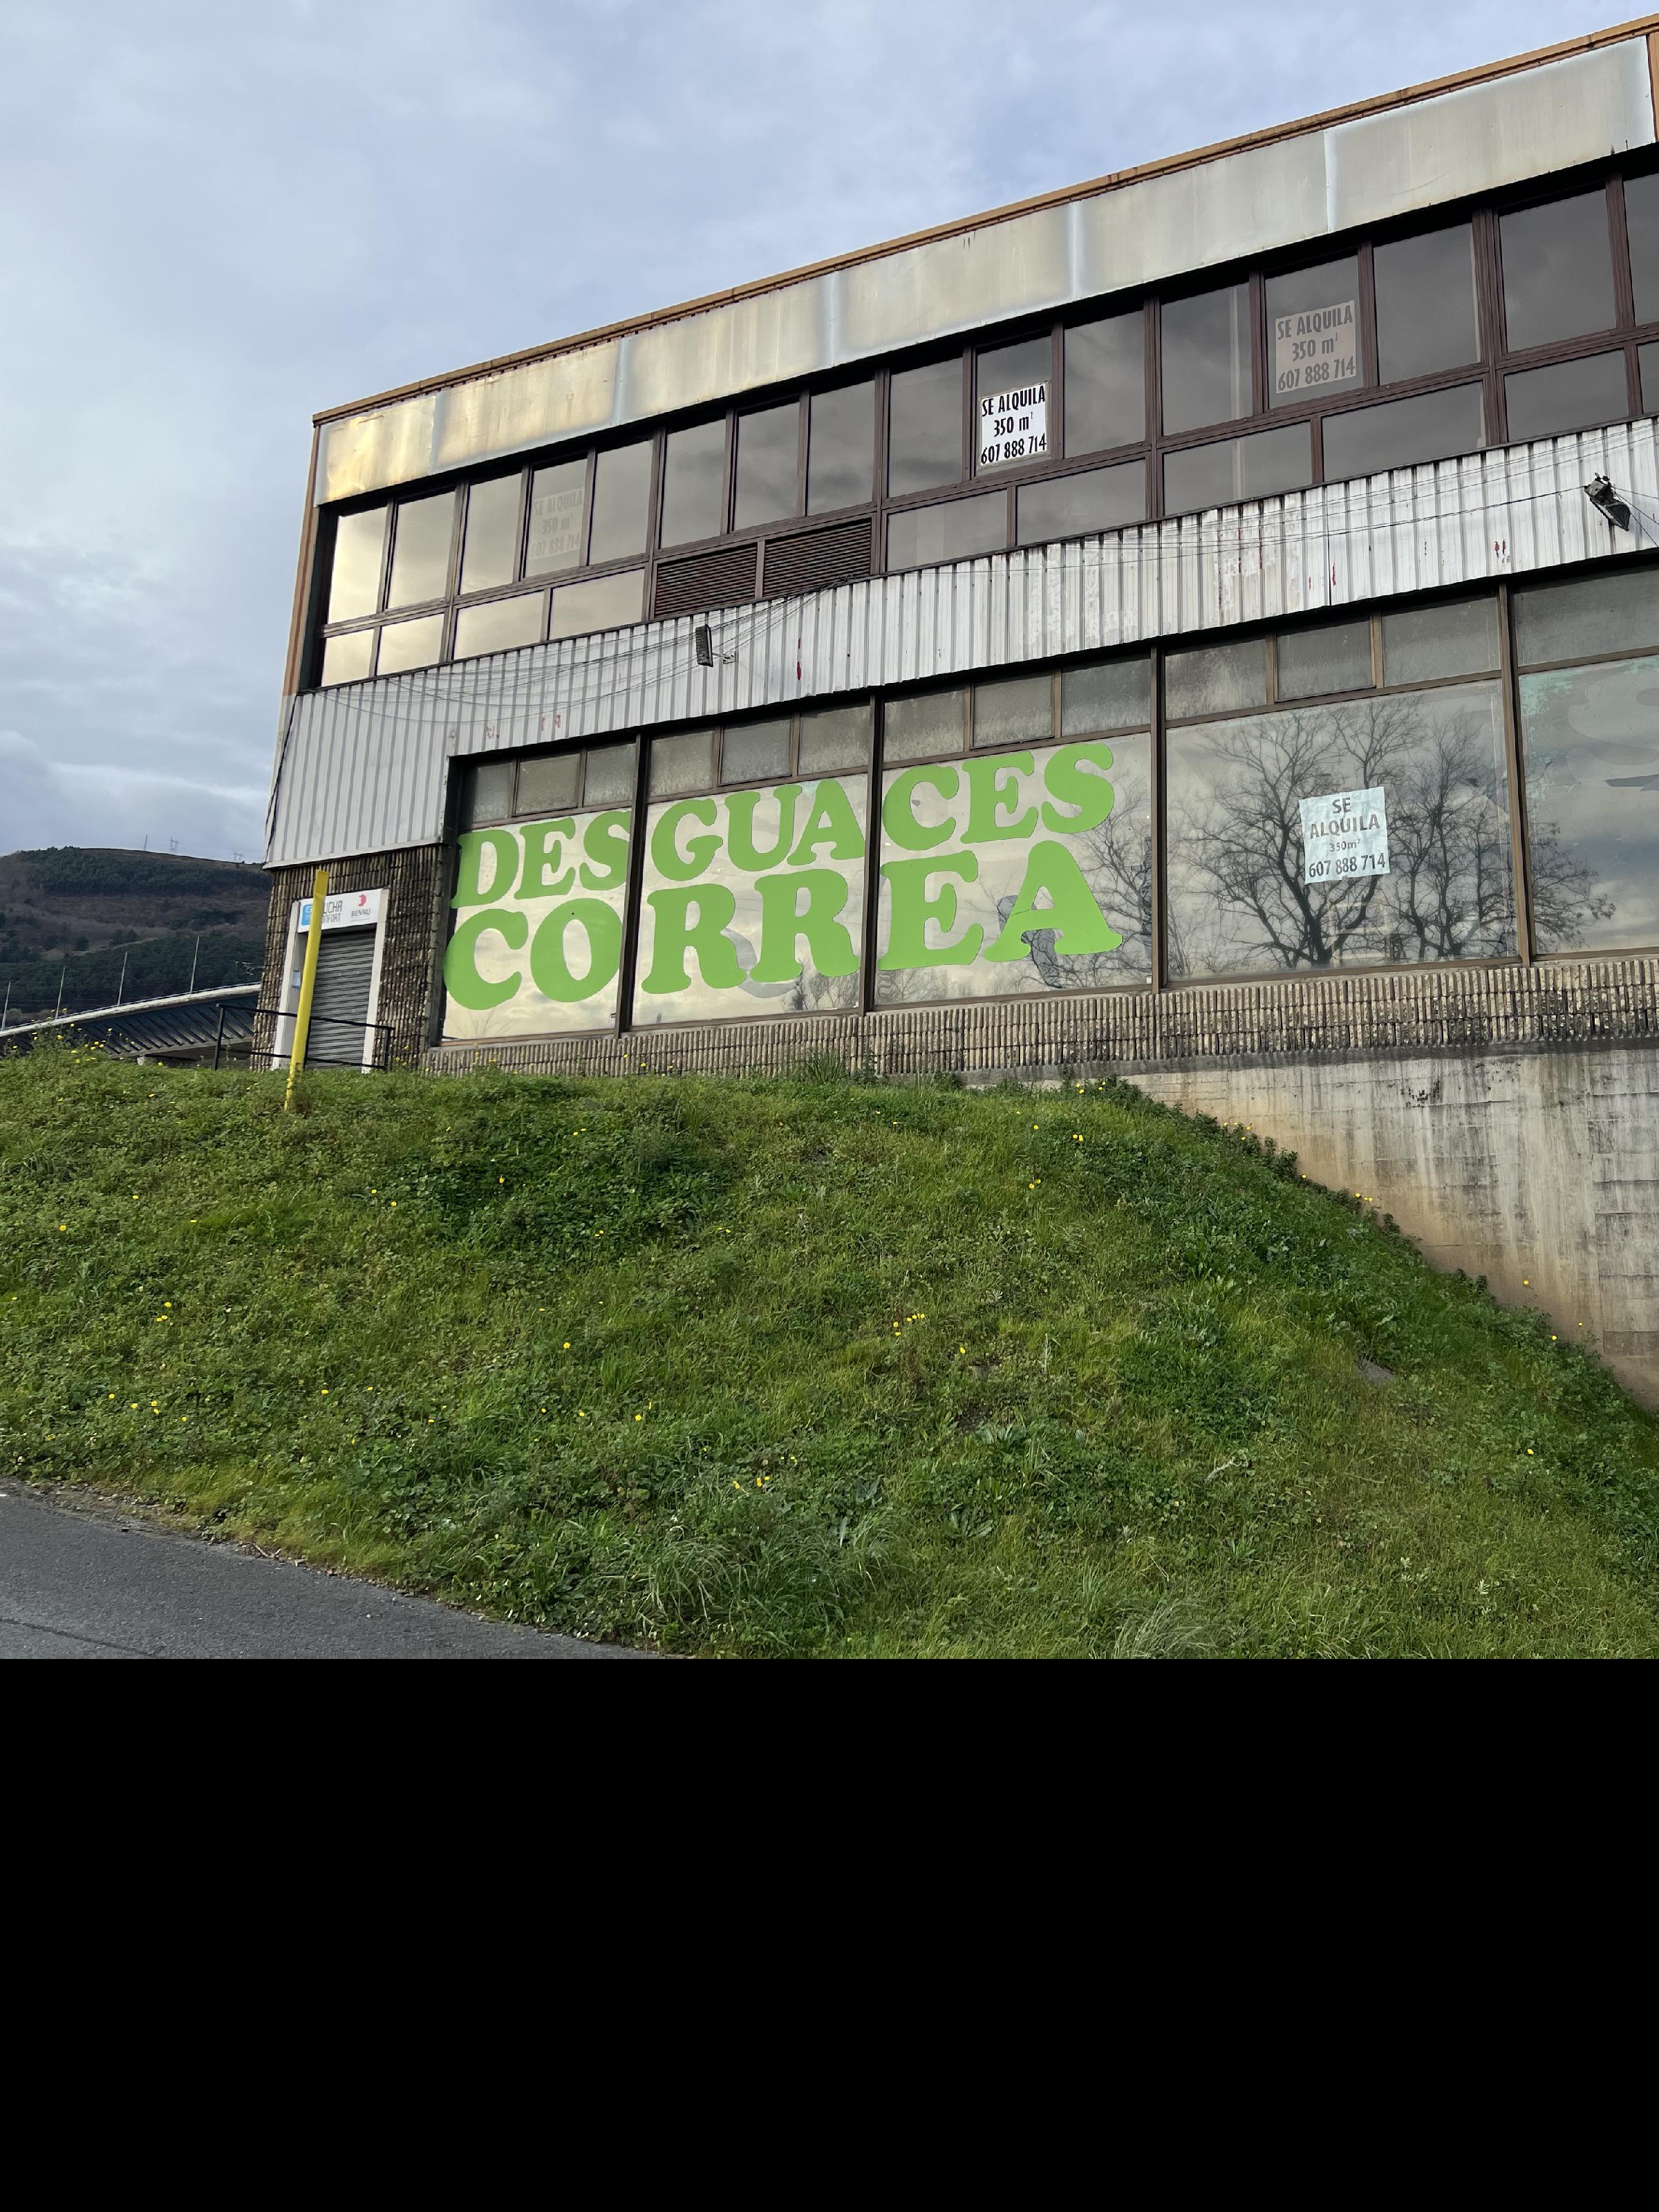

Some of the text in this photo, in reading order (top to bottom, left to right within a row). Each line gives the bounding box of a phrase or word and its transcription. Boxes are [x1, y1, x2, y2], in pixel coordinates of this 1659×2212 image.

[1277, 305, 1353, 340] SE ALQUILA
[1293, 339, 1316, 362] 350
[1278, 355, 1356, 391] 607 888 714
[982, 385, 1045, 417] SE ALQUILA
[994, 416, 1014, 437] 350
[981, 433, 1047, 465] 607 888 714
[533, 490, 583, 516] SE ALQUILA
[541, 517, 559, 535] 350
[548, 536, 565, 554] 888
[566, 532, 581, 550] 714
[1332, 797, 1351, 814] SE
[451, 742, 1115, 908] DESGUACES
[1310, 814, 1380, 839] ALQUILA
[1309, 852, 1386, 878] 607 888 714
[444, 840, 1123, 1010] CORREA
